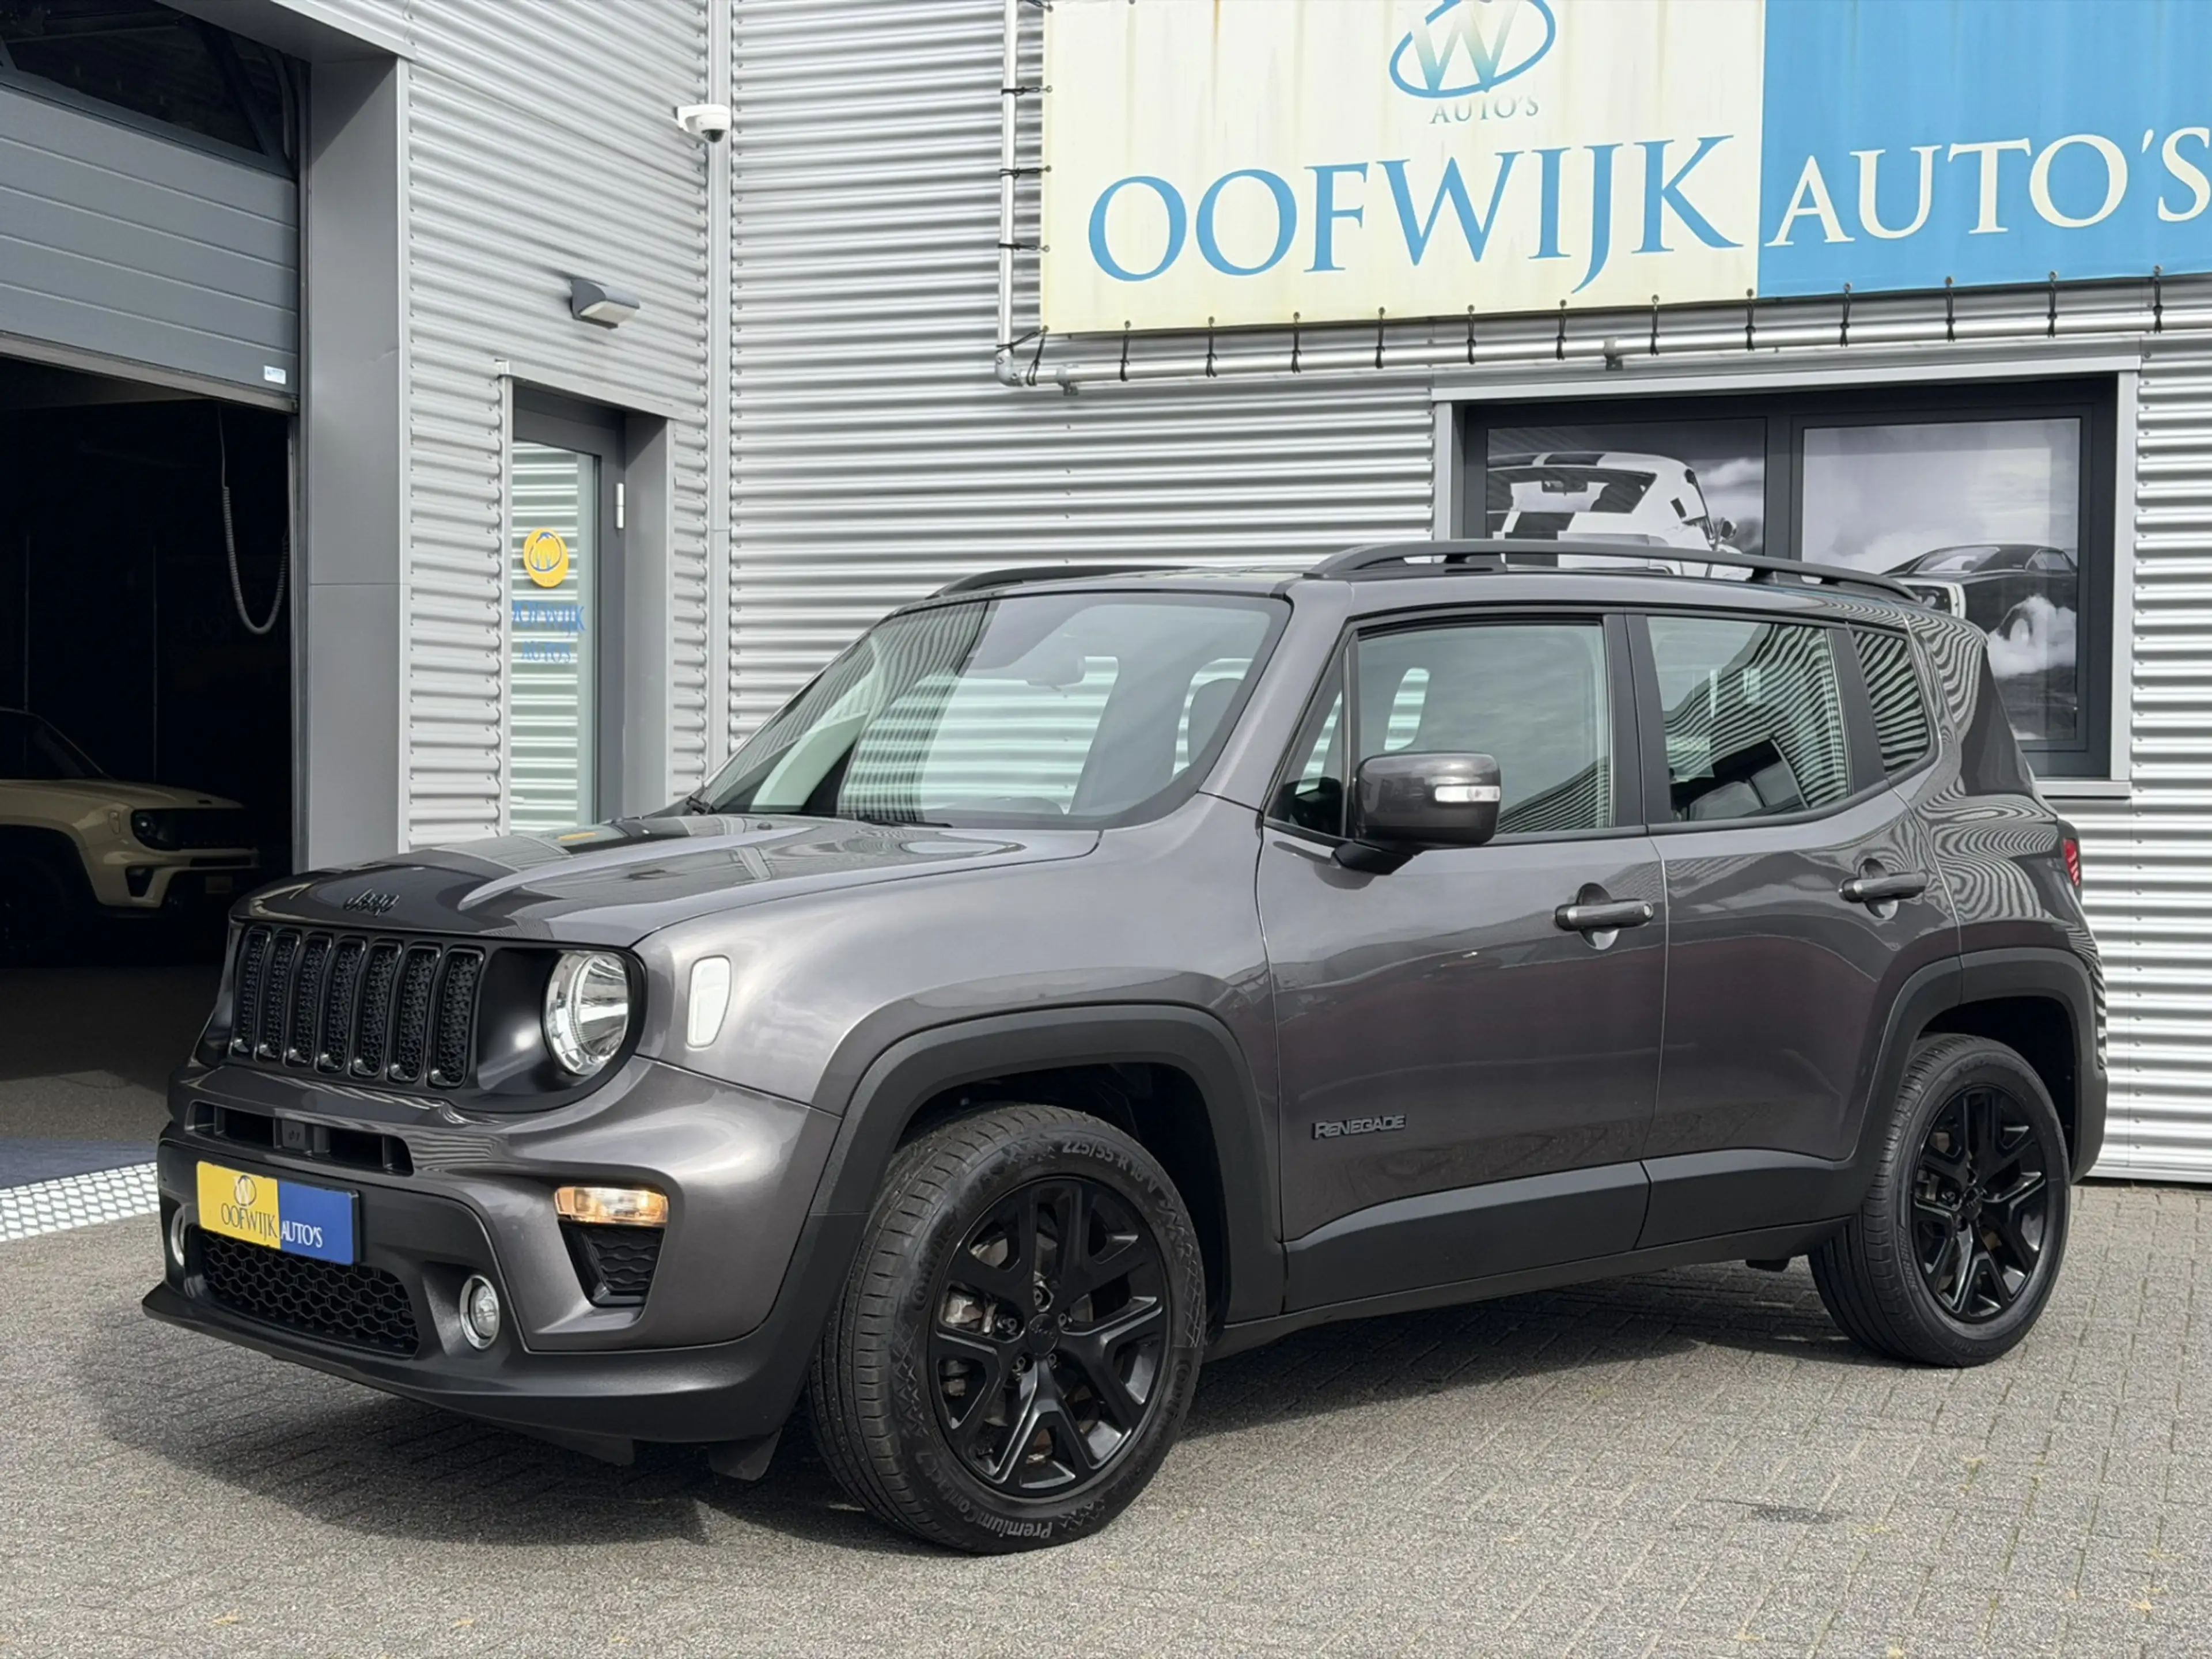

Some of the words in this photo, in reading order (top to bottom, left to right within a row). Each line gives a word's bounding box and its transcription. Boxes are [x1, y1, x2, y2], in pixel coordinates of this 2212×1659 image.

[1429, 95, 1539, 124] AUTO'S
[1088, 135, 1744, 294] OOFWIJK
[1764, 127, 2211, 247] AUTO'S
[1312, 1114, 1406, 1139] RENEGADE
[1062, 1139, 1115, 1162] 225/55
[221, 1202, 278, 1241] OOFWIJK
[281, 1219, 323, 1248] AUTO'S
